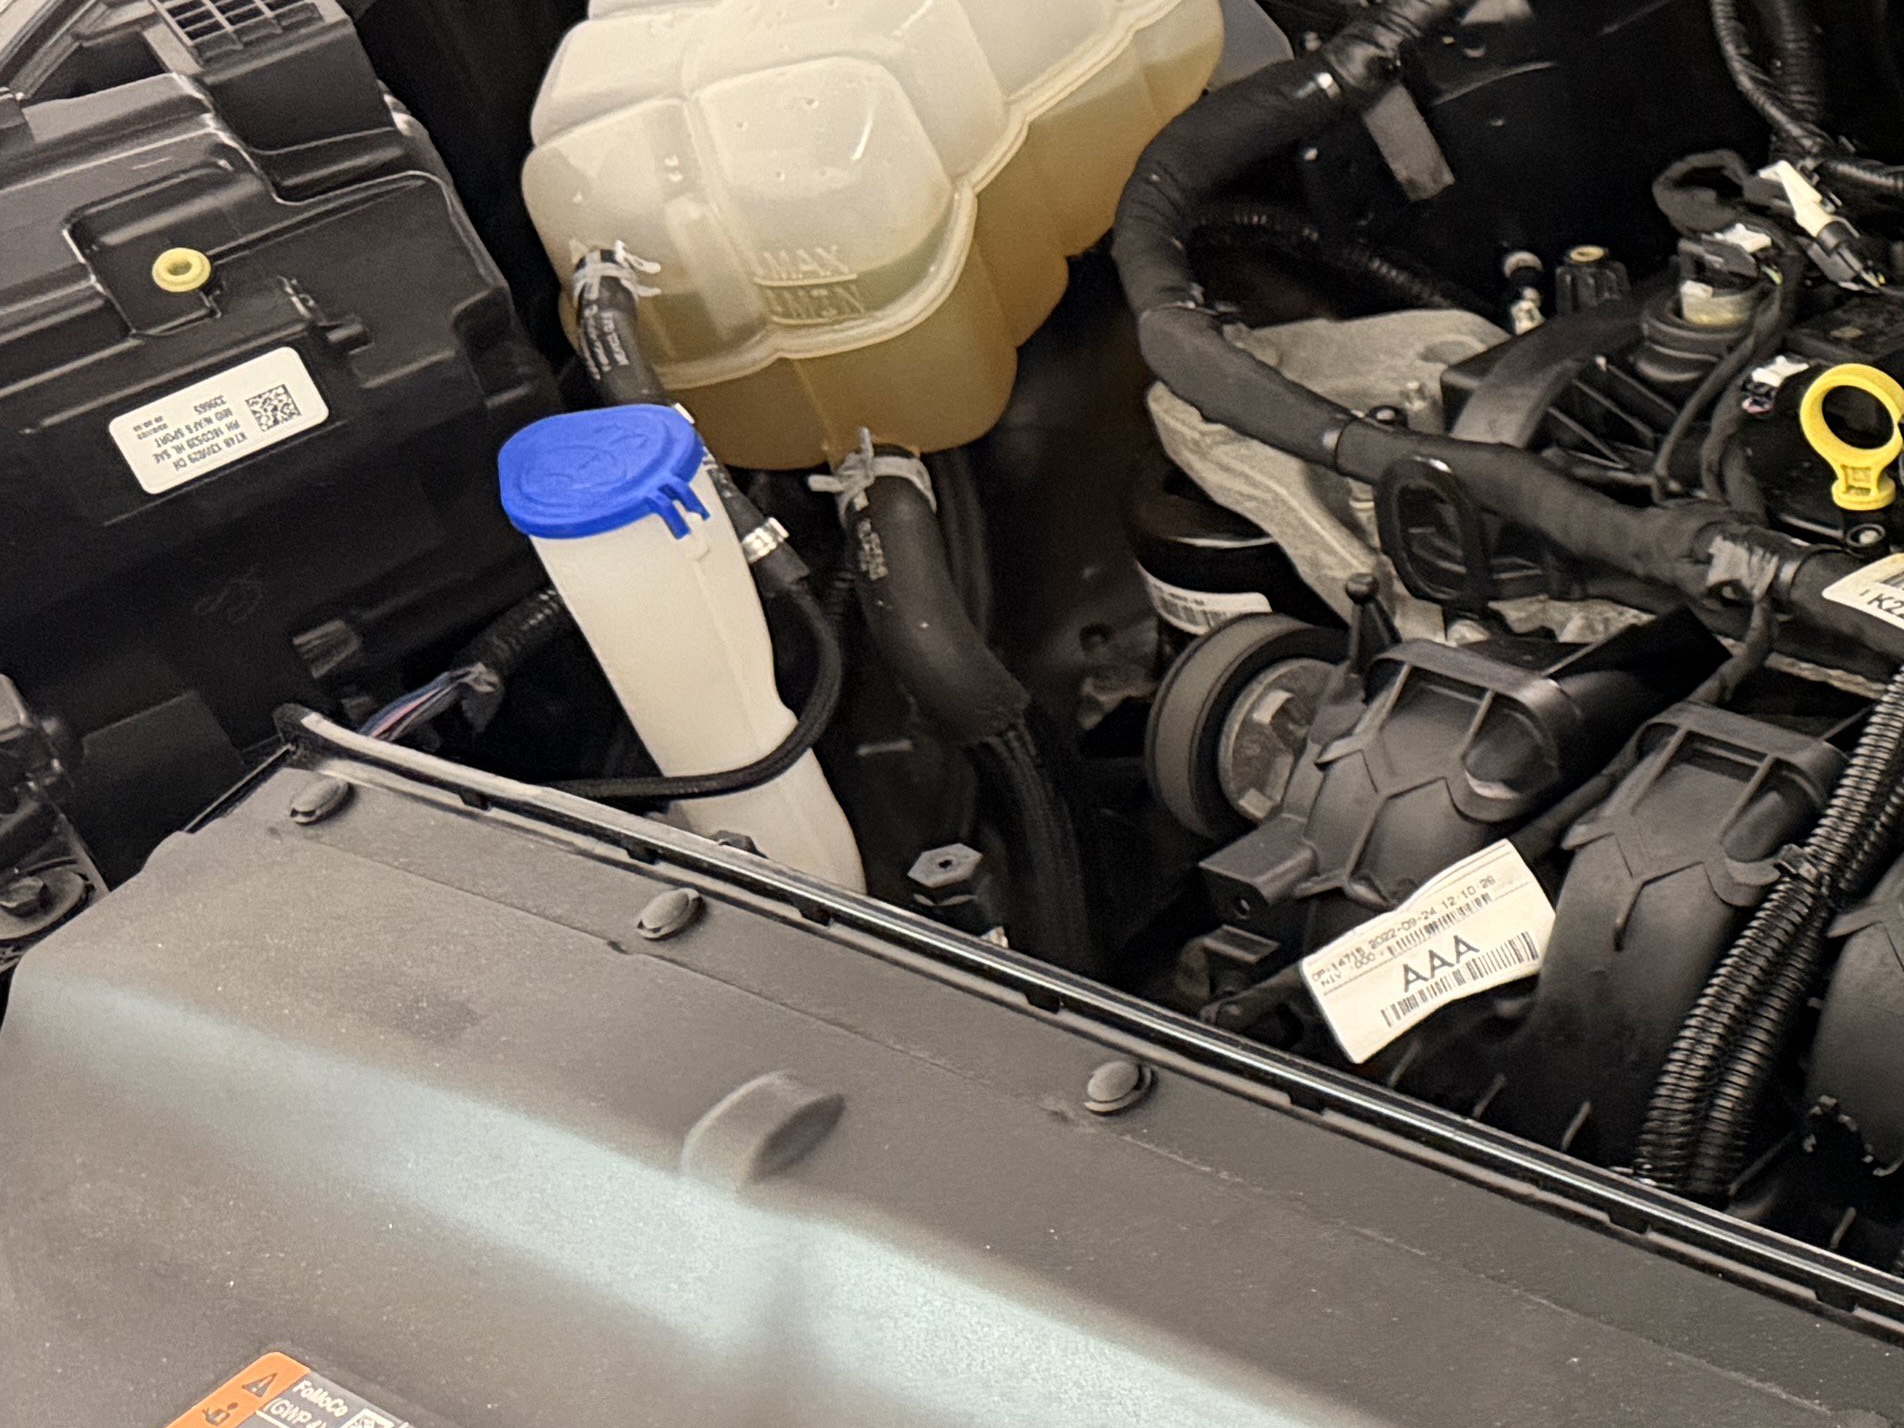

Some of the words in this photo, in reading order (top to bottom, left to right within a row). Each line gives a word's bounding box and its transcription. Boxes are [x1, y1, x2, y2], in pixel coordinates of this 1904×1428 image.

[763, 245, 849, 279] MAX
[154, 428, 186, 448] SPORT
[1403, 935, 1480, 993] AAA
[292, 1380, 348, 1417] FoMoCo
